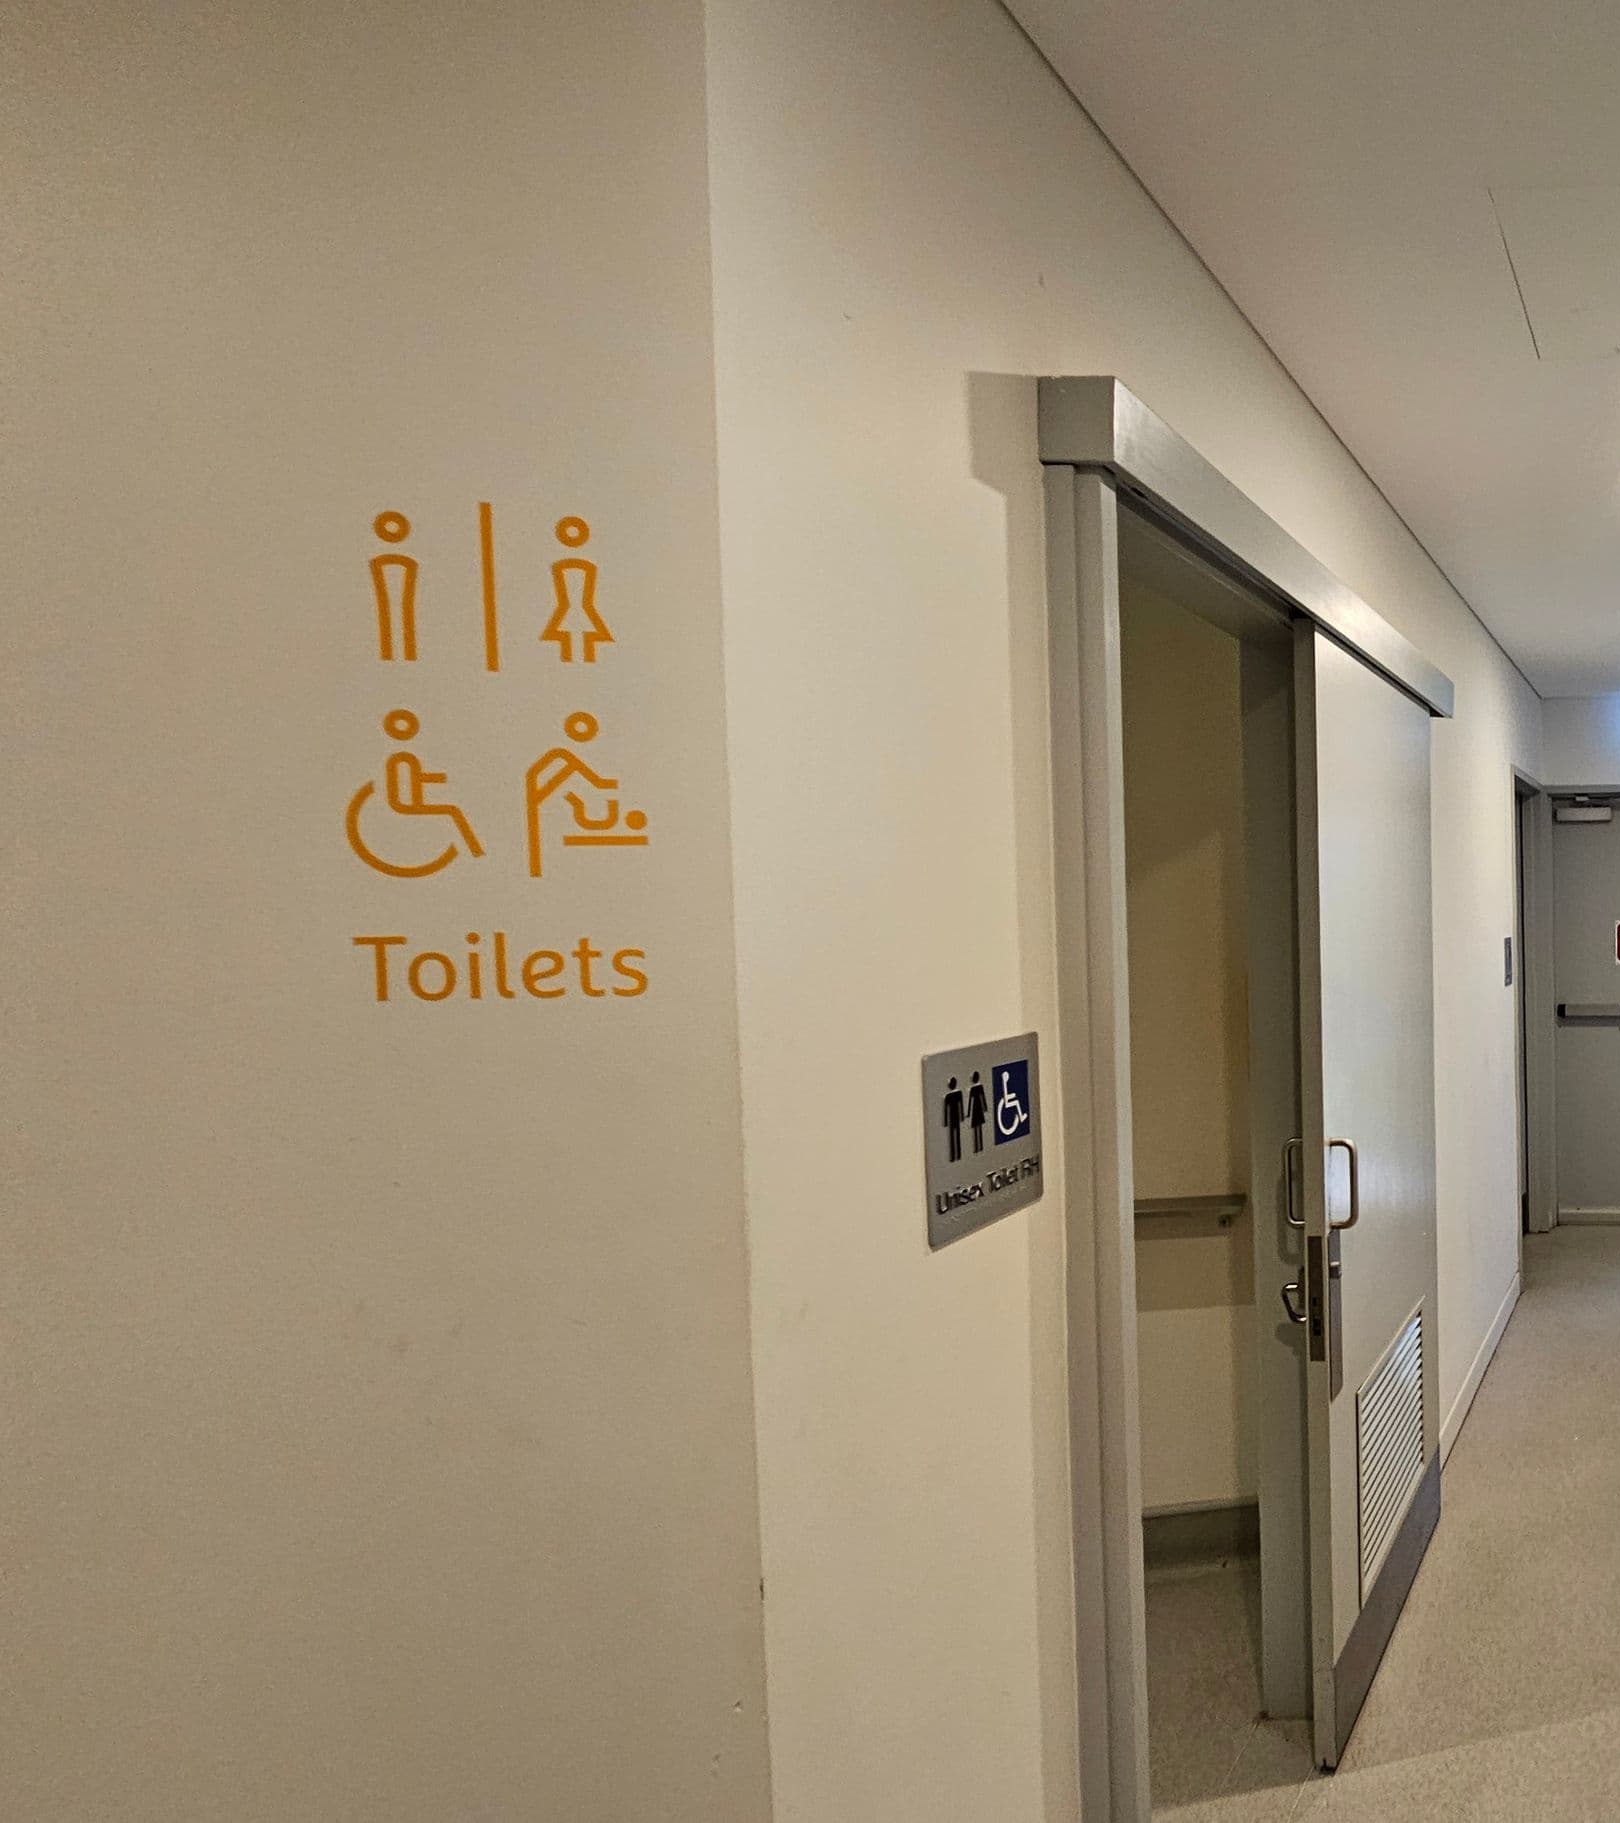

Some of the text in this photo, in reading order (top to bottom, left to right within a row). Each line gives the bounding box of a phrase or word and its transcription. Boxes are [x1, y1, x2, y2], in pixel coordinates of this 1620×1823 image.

[352, 931, 649, 1001] Toilets
[936, 1154, 1040, 1215] Unisex Toilet RH
